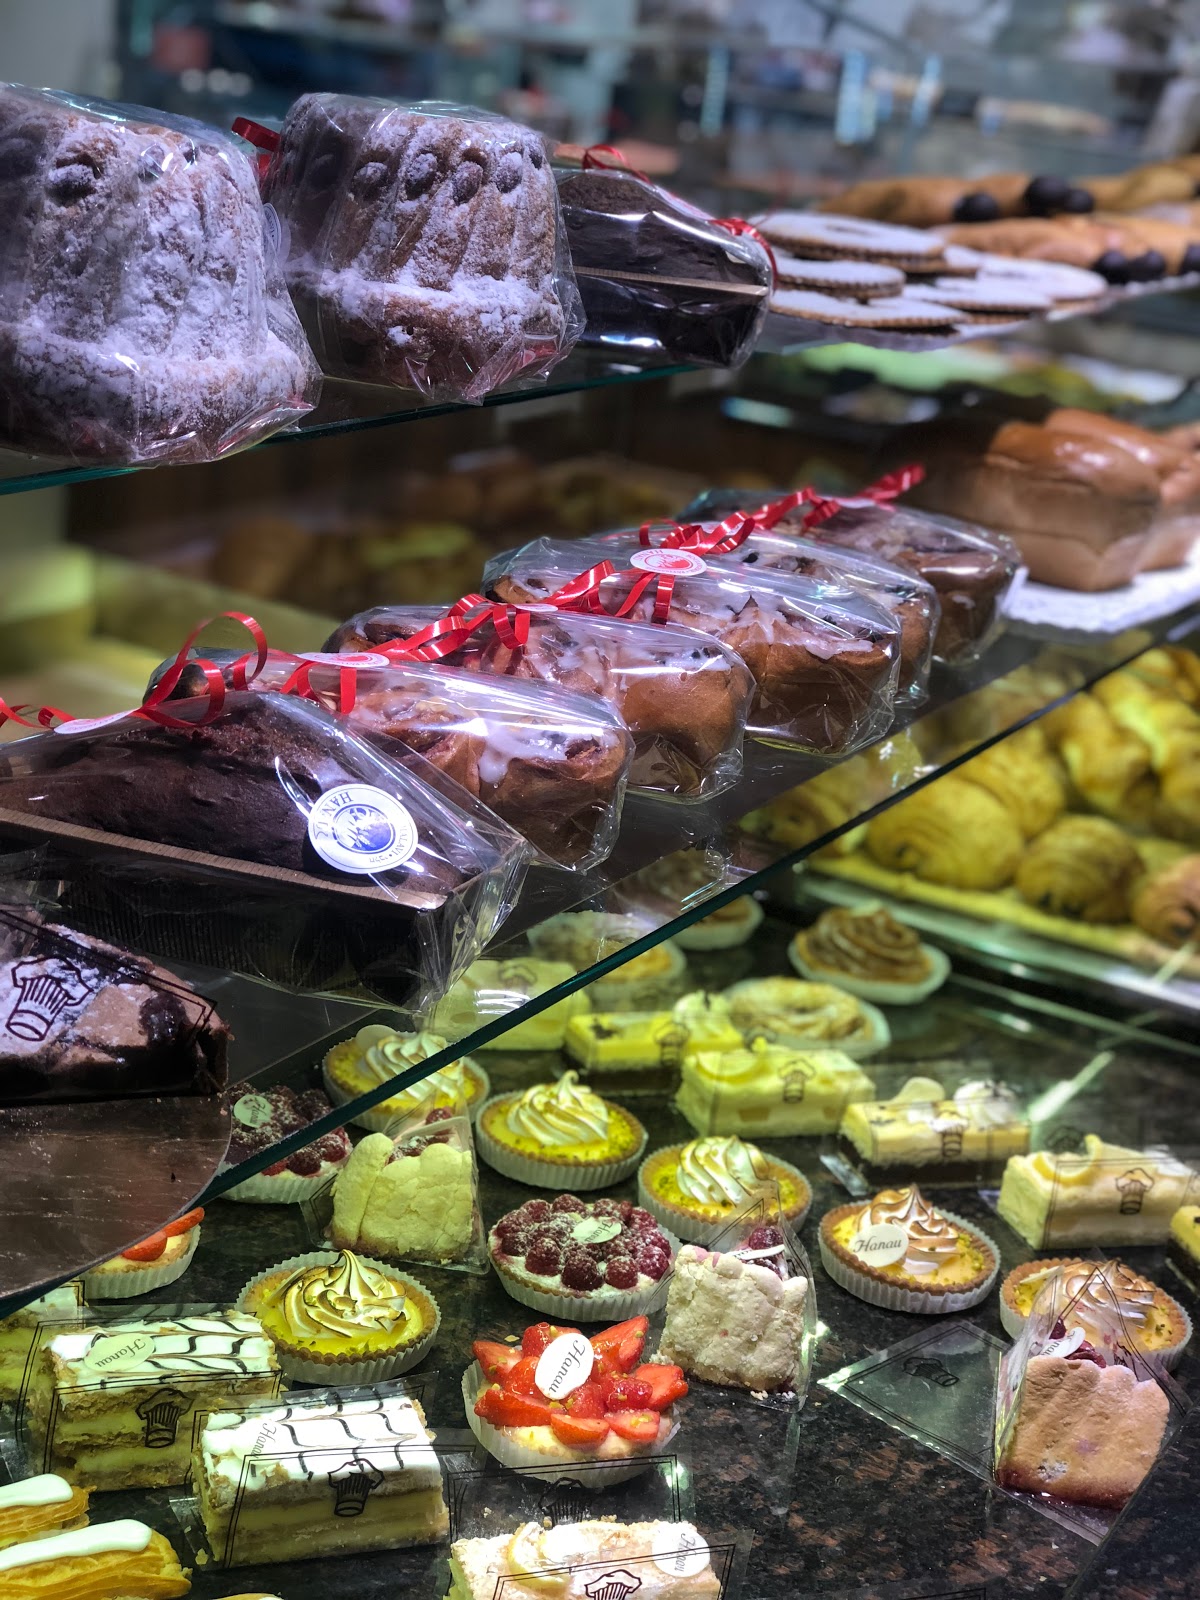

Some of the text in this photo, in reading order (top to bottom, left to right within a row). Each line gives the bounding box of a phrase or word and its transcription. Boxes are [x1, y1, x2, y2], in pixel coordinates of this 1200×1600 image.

[853, 1235, 902, 1253] Hanau
[94, 1338, 147, 1367] Hanau
[548, 1339, 586, 1393] Hanau
[250, 1422, 277, 1459] Hanau
[674, 1532, 697, 1572] Hanau
